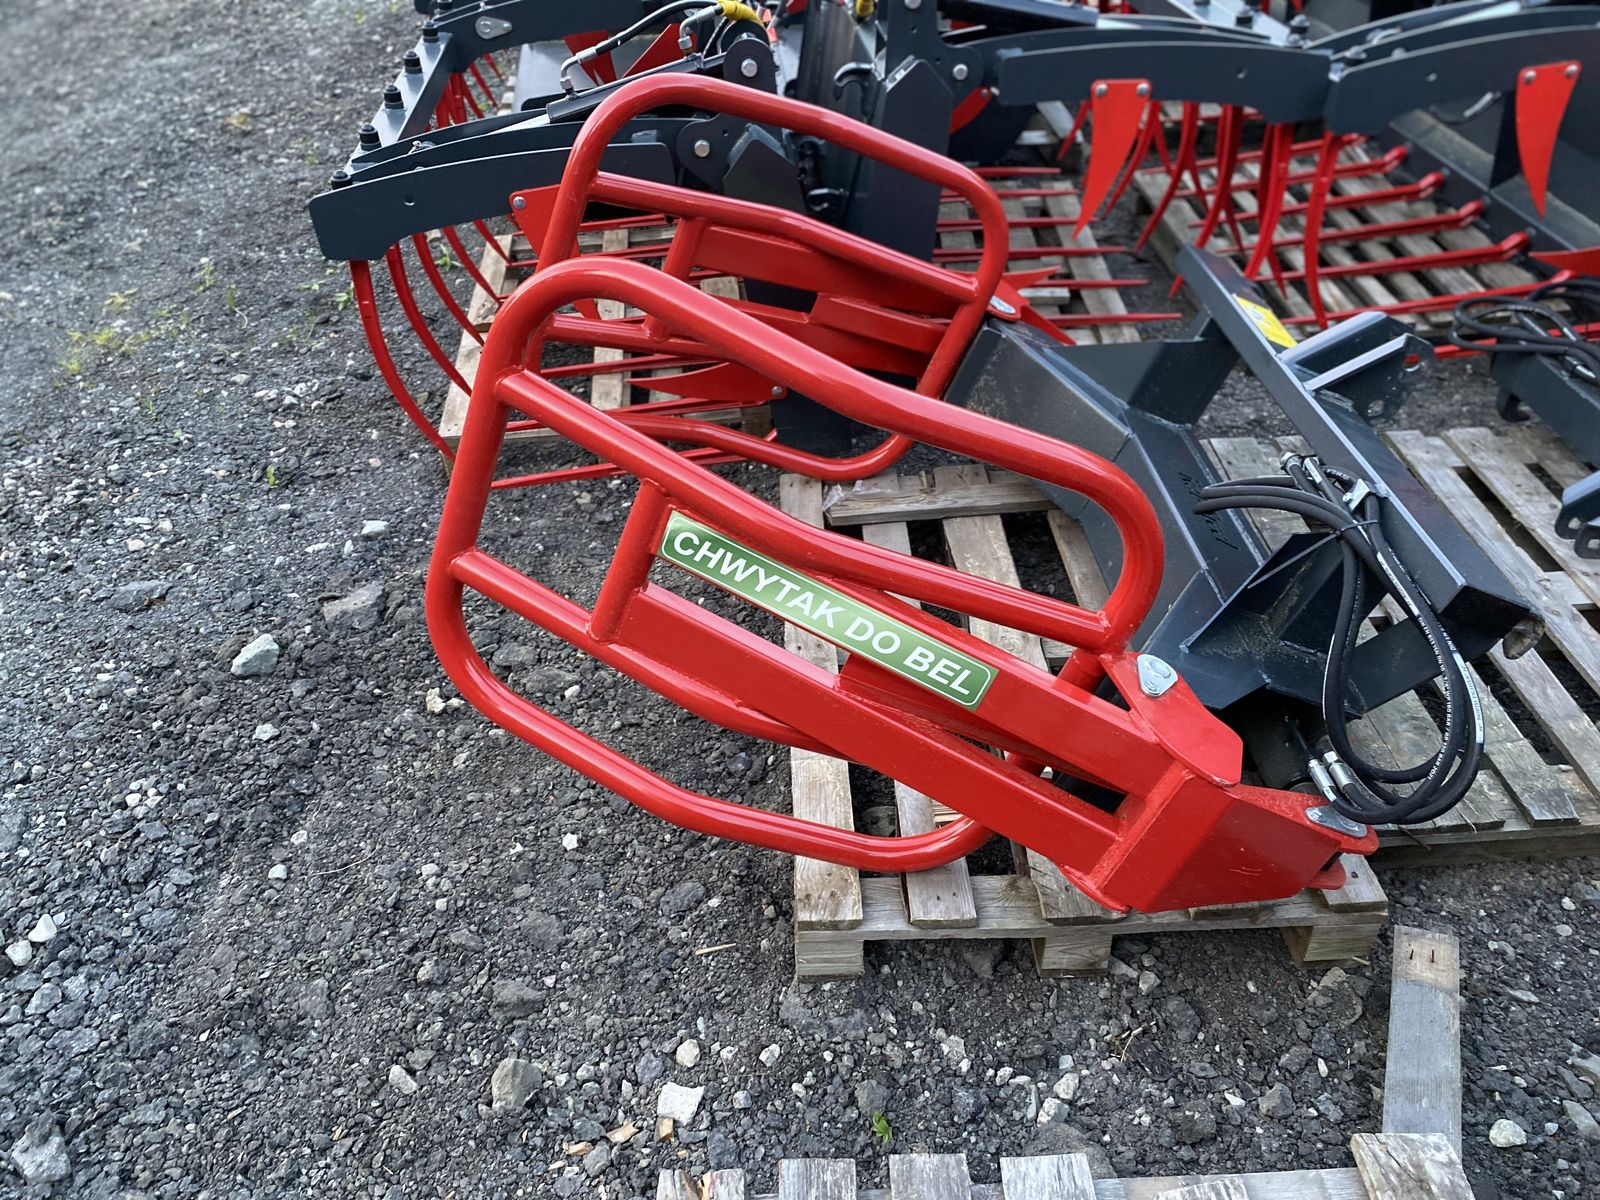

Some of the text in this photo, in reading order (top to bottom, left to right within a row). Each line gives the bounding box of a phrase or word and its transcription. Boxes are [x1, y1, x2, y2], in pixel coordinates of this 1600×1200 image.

[673, 531, 979, 696] CHWYTAK DO BEL
